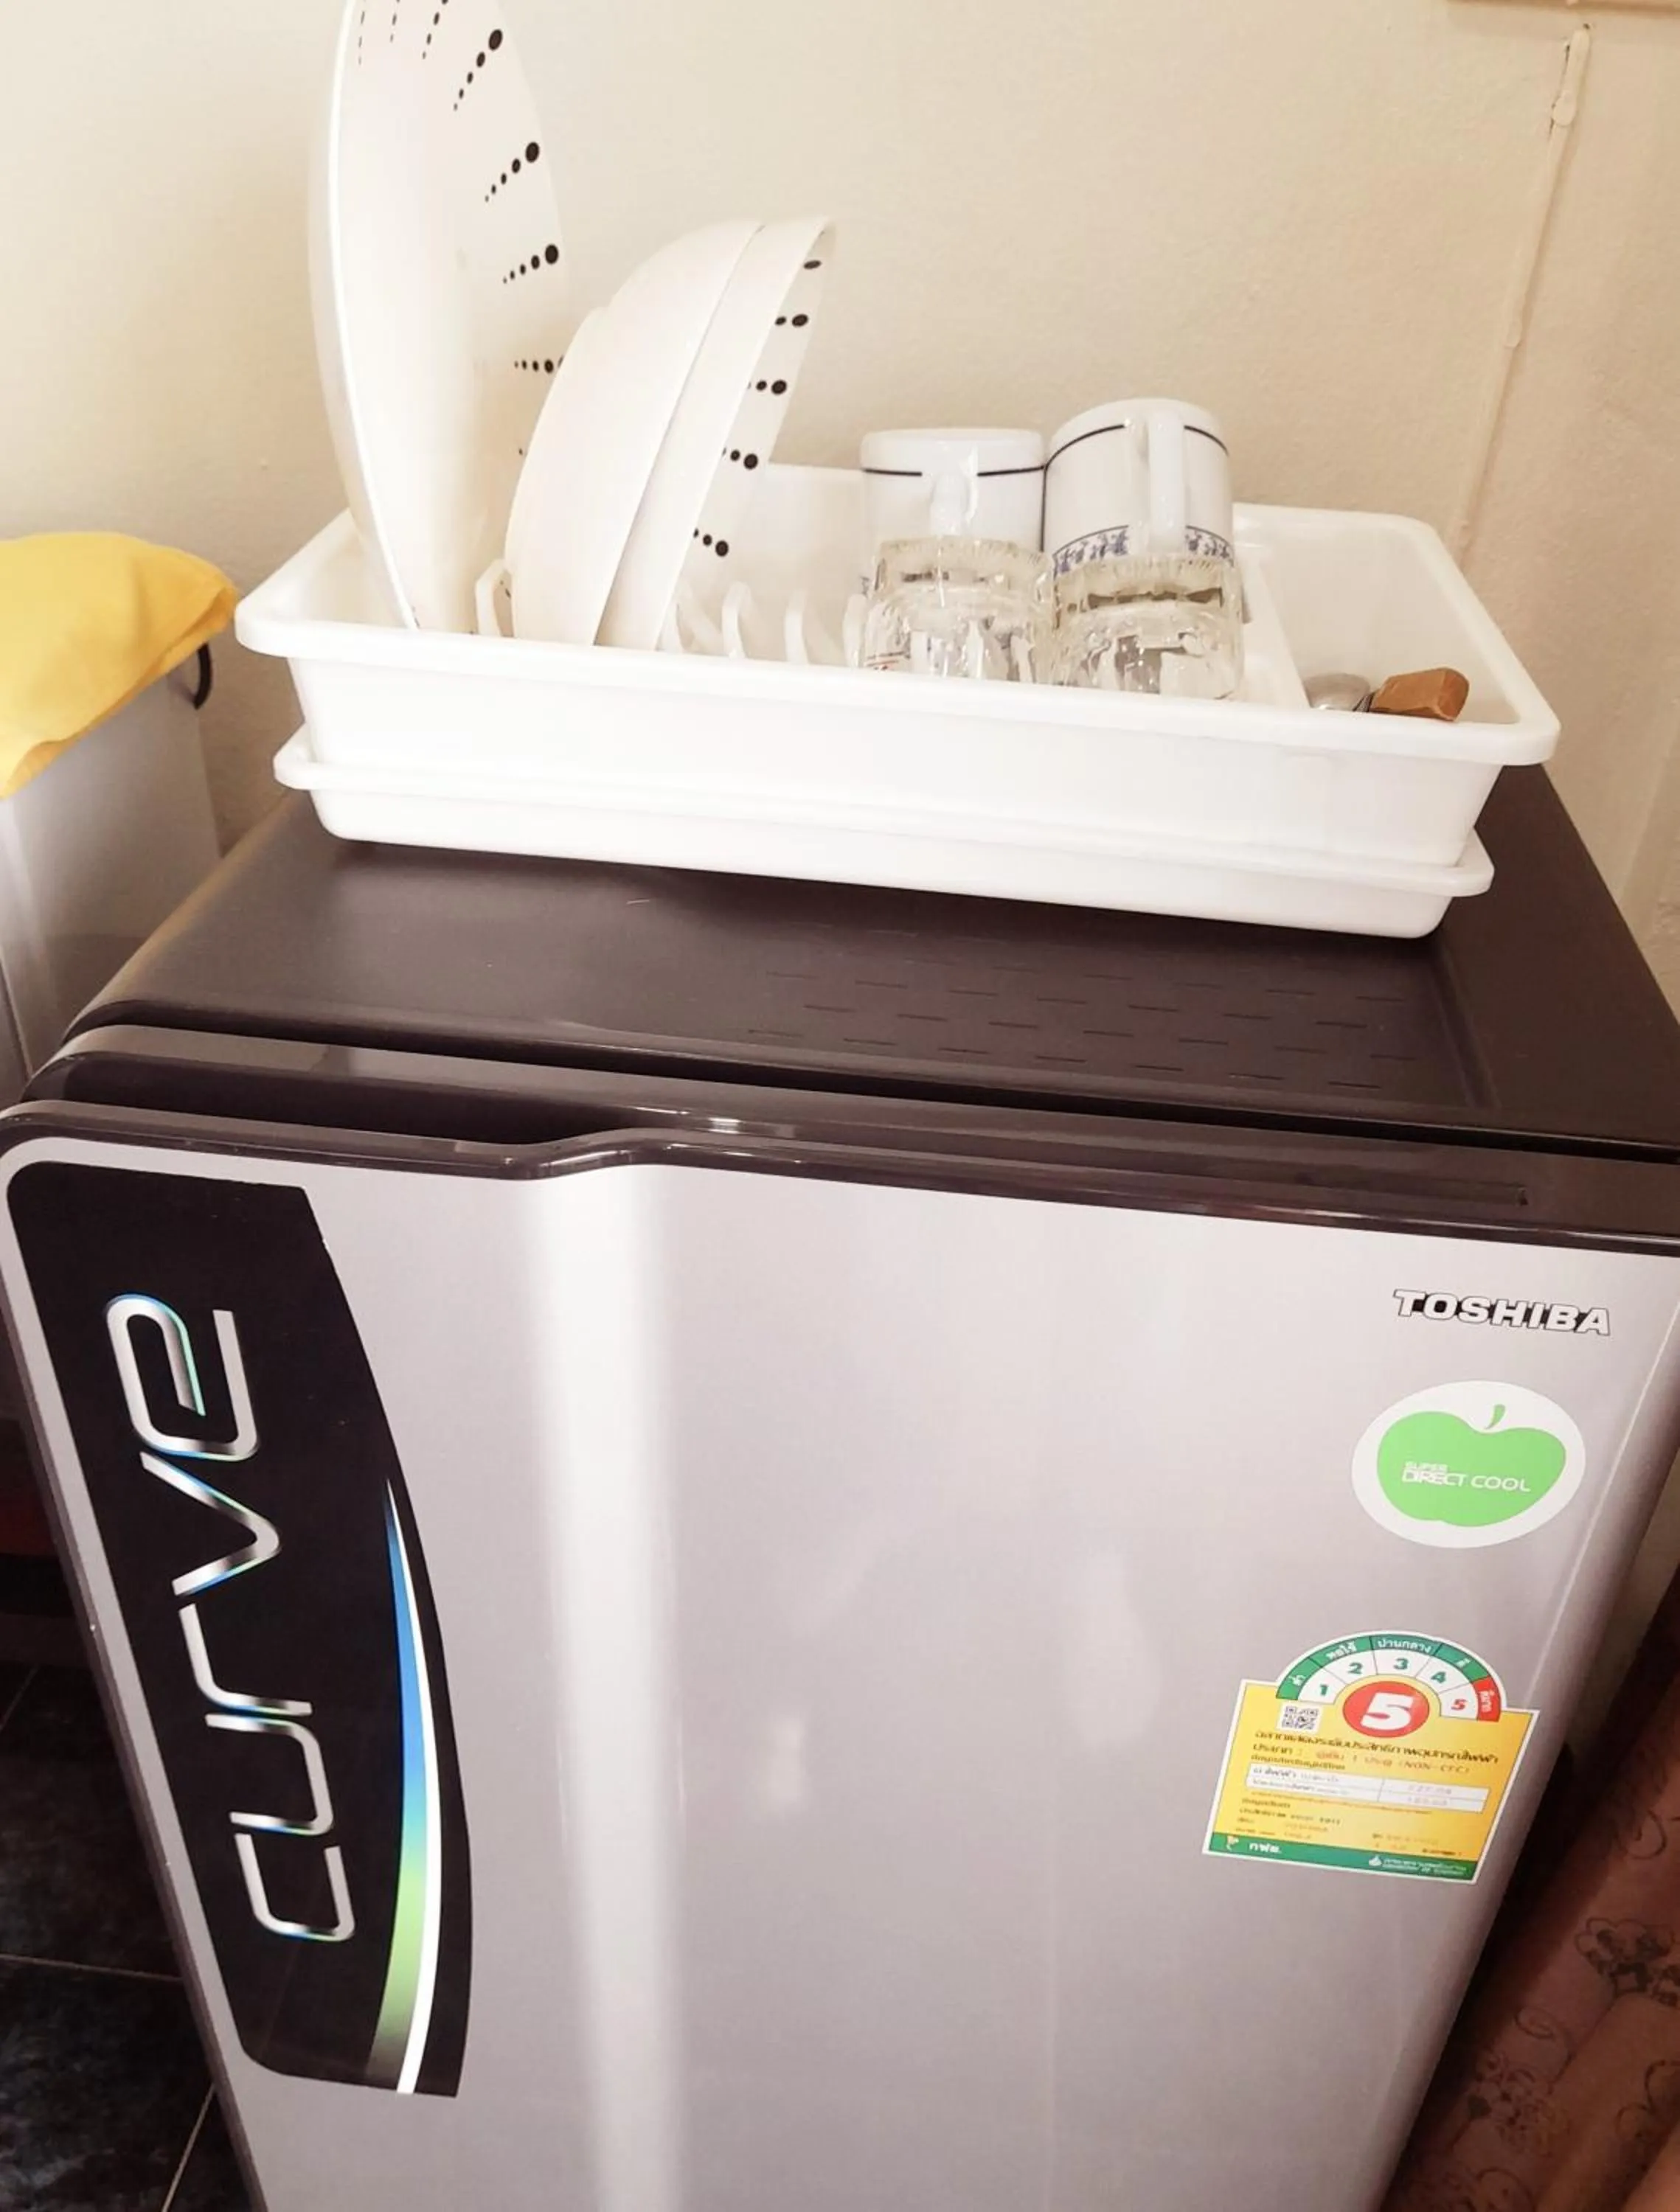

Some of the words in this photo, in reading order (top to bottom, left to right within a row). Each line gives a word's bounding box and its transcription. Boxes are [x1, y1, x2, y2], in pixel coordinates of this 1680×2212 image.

[1393, 1290, 1610, 1335] TOSHIBA
[1401, 1467, 1467, 1487] DIRECT
[1471, 1475, 1531, 1492] COOL
[1319, 1683, 1328, 1696] 1
[1348, 1662, 1363, 1674] 2
[1394, 1658, 1409, 1670] 3
[1431, 1671, 1447, 1683] 4
[1451, 1698, 1468, 1711] 5
[1360, 1691, 1415, 1731] 5
